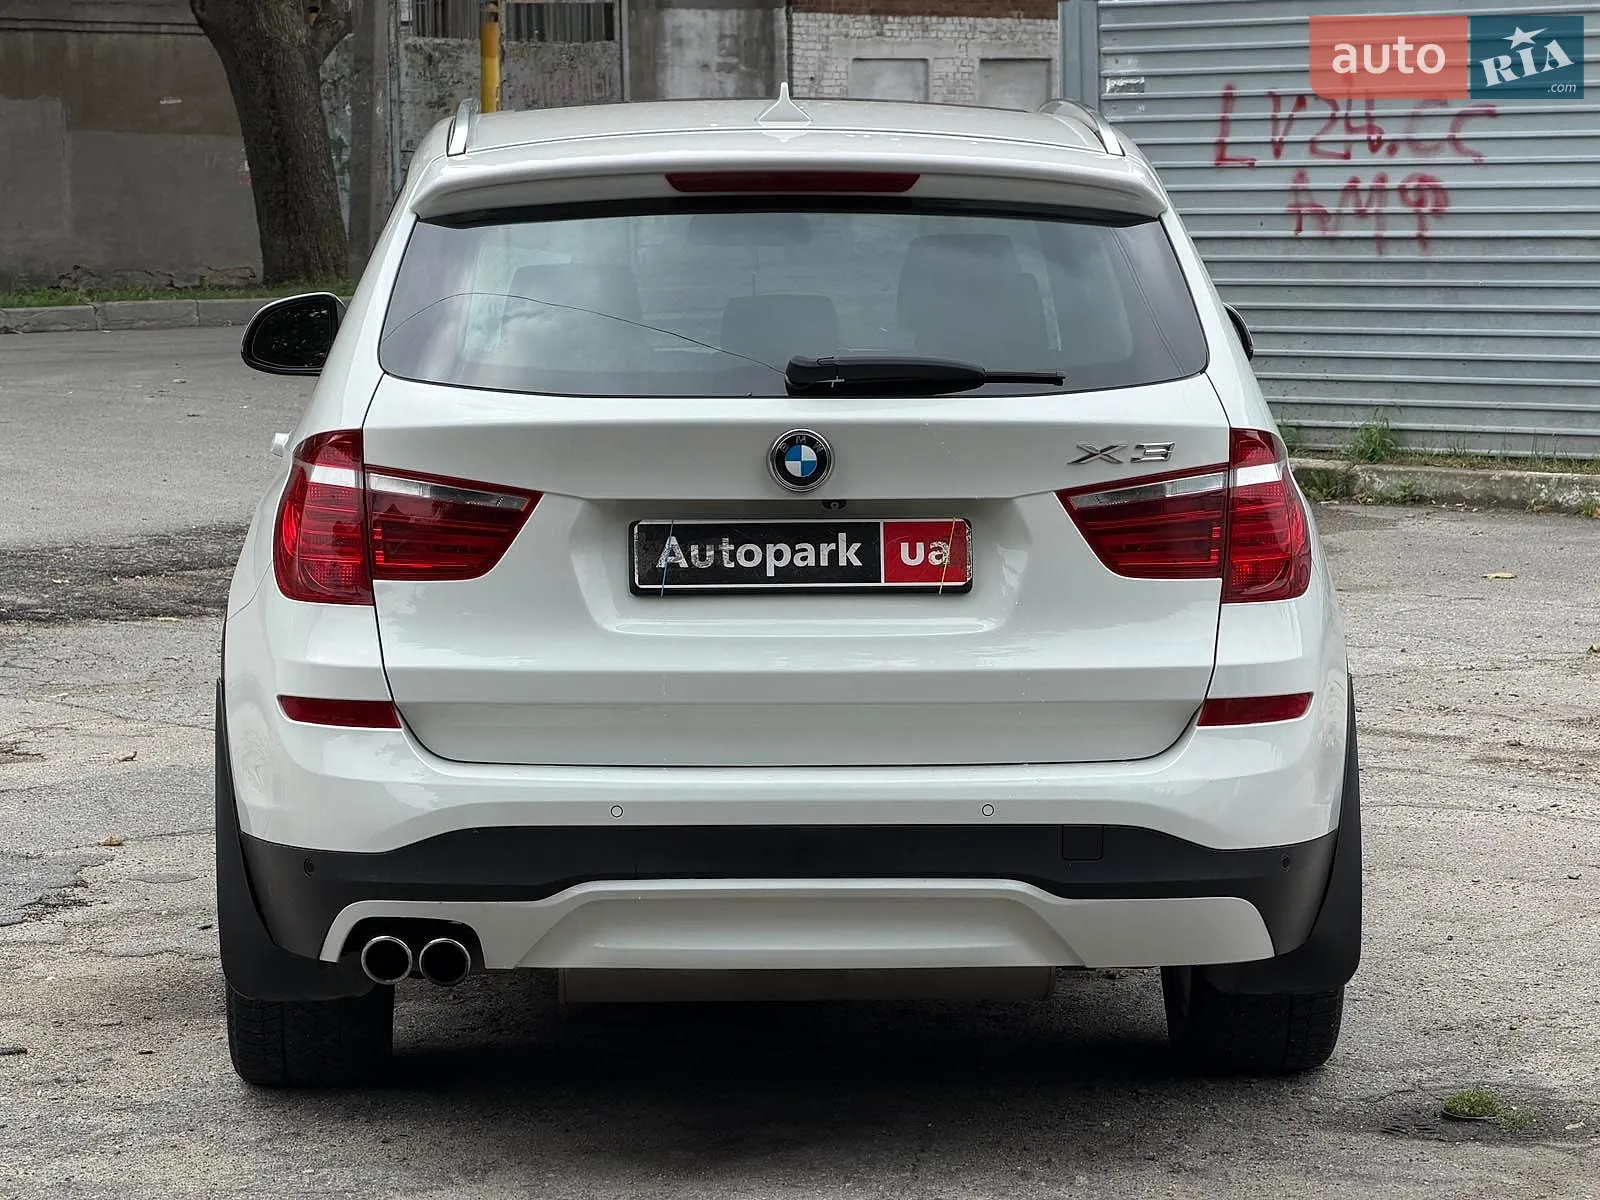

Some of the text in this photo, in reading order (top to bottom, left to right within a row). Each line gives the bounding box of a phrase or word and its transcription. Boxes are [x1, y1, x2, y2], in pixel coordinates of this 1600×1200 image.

[779, 435, 824, 454] BMW
[1066, 441, 1177, 465] X3
[655, 532, 951, 577] Autopark ua
